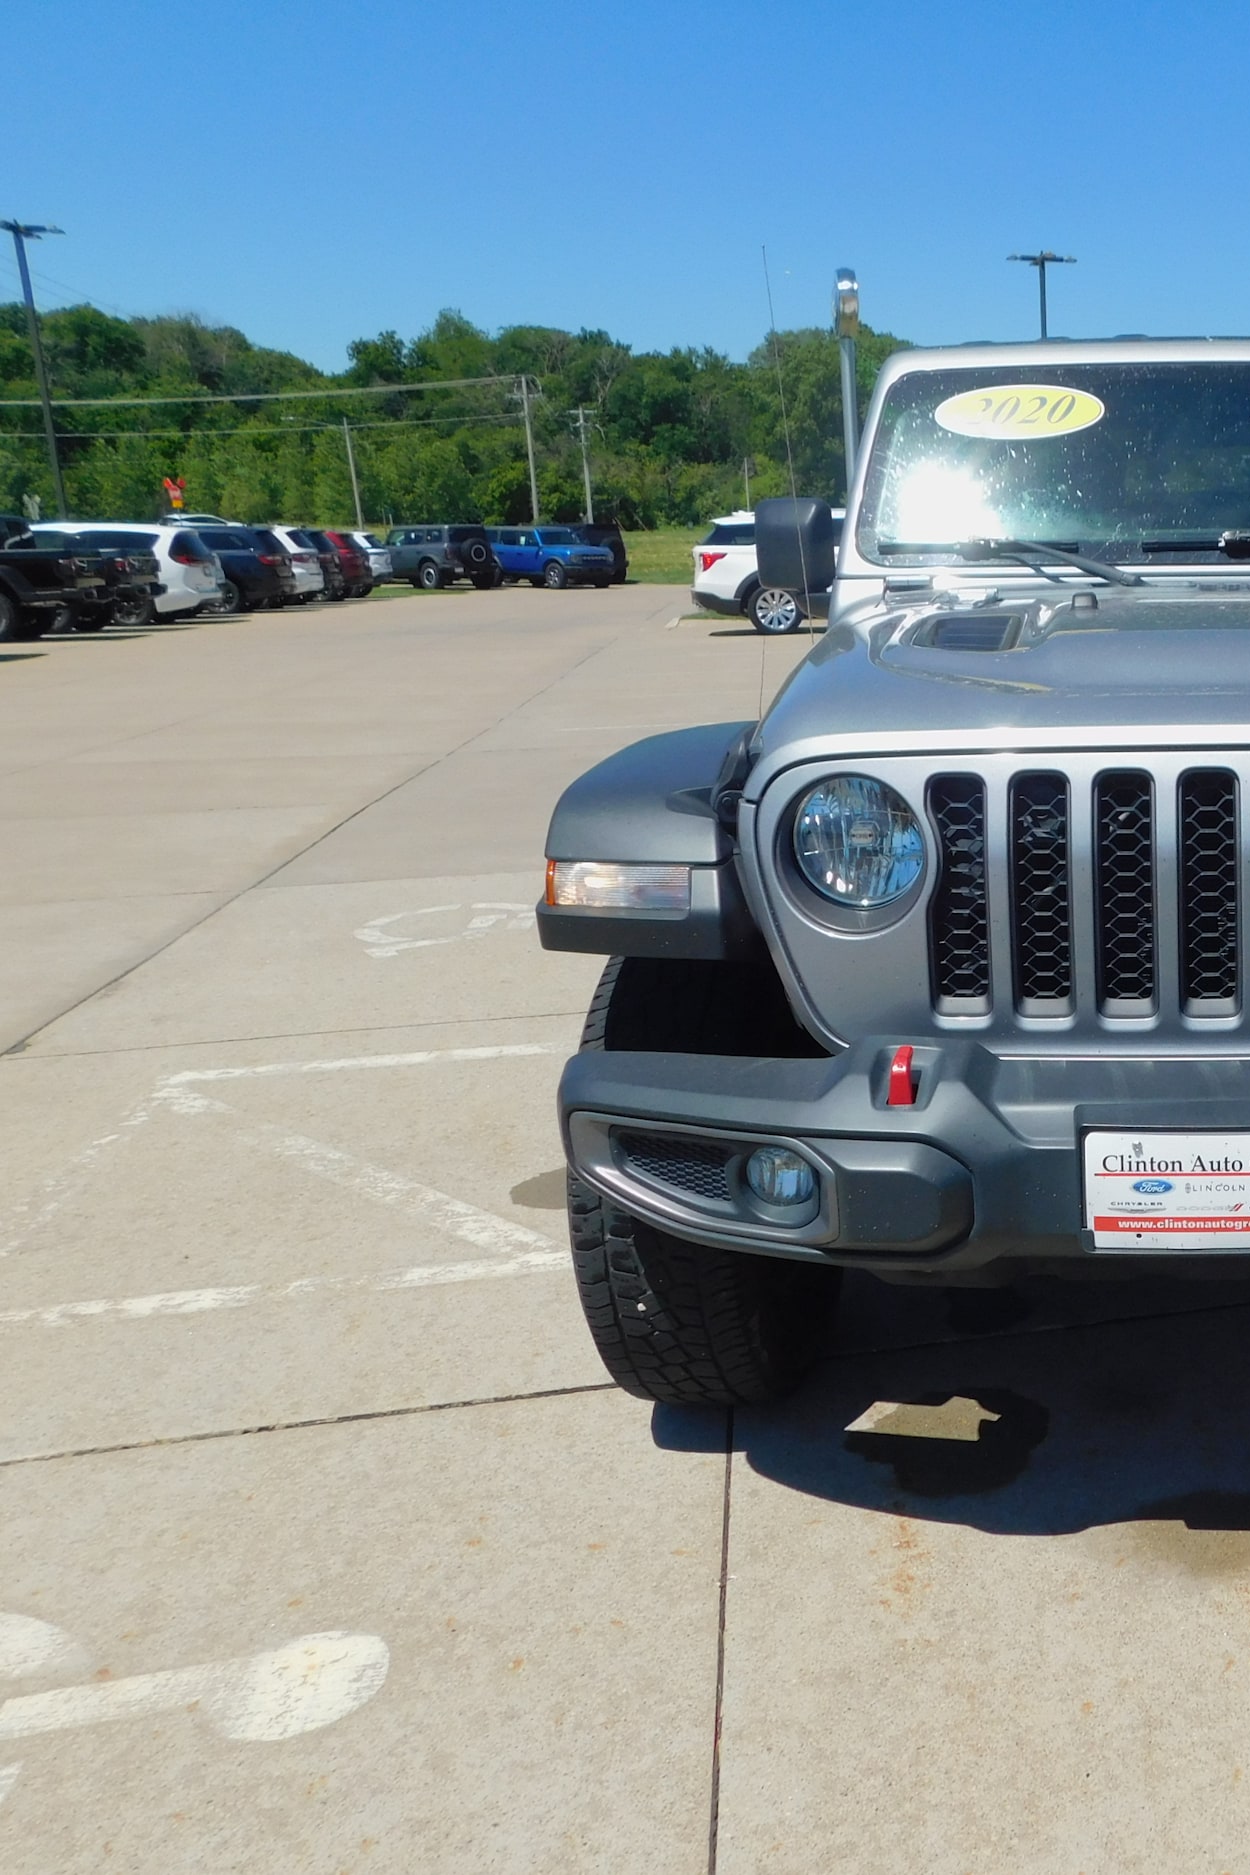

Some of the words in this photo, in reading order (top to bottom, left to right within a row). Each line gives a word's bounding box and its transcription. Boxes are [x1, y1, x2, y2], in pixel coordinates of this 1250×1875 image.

[967, 394, 1077, 425] 2020
[1102, 1155, 1183, 1173] Clinton
[1191, 1155, 1243, 1172] Auto
[1139, 1181, 1165, 1193] Ford
[1192, 1183, 1246, 1193] LINCOLN
